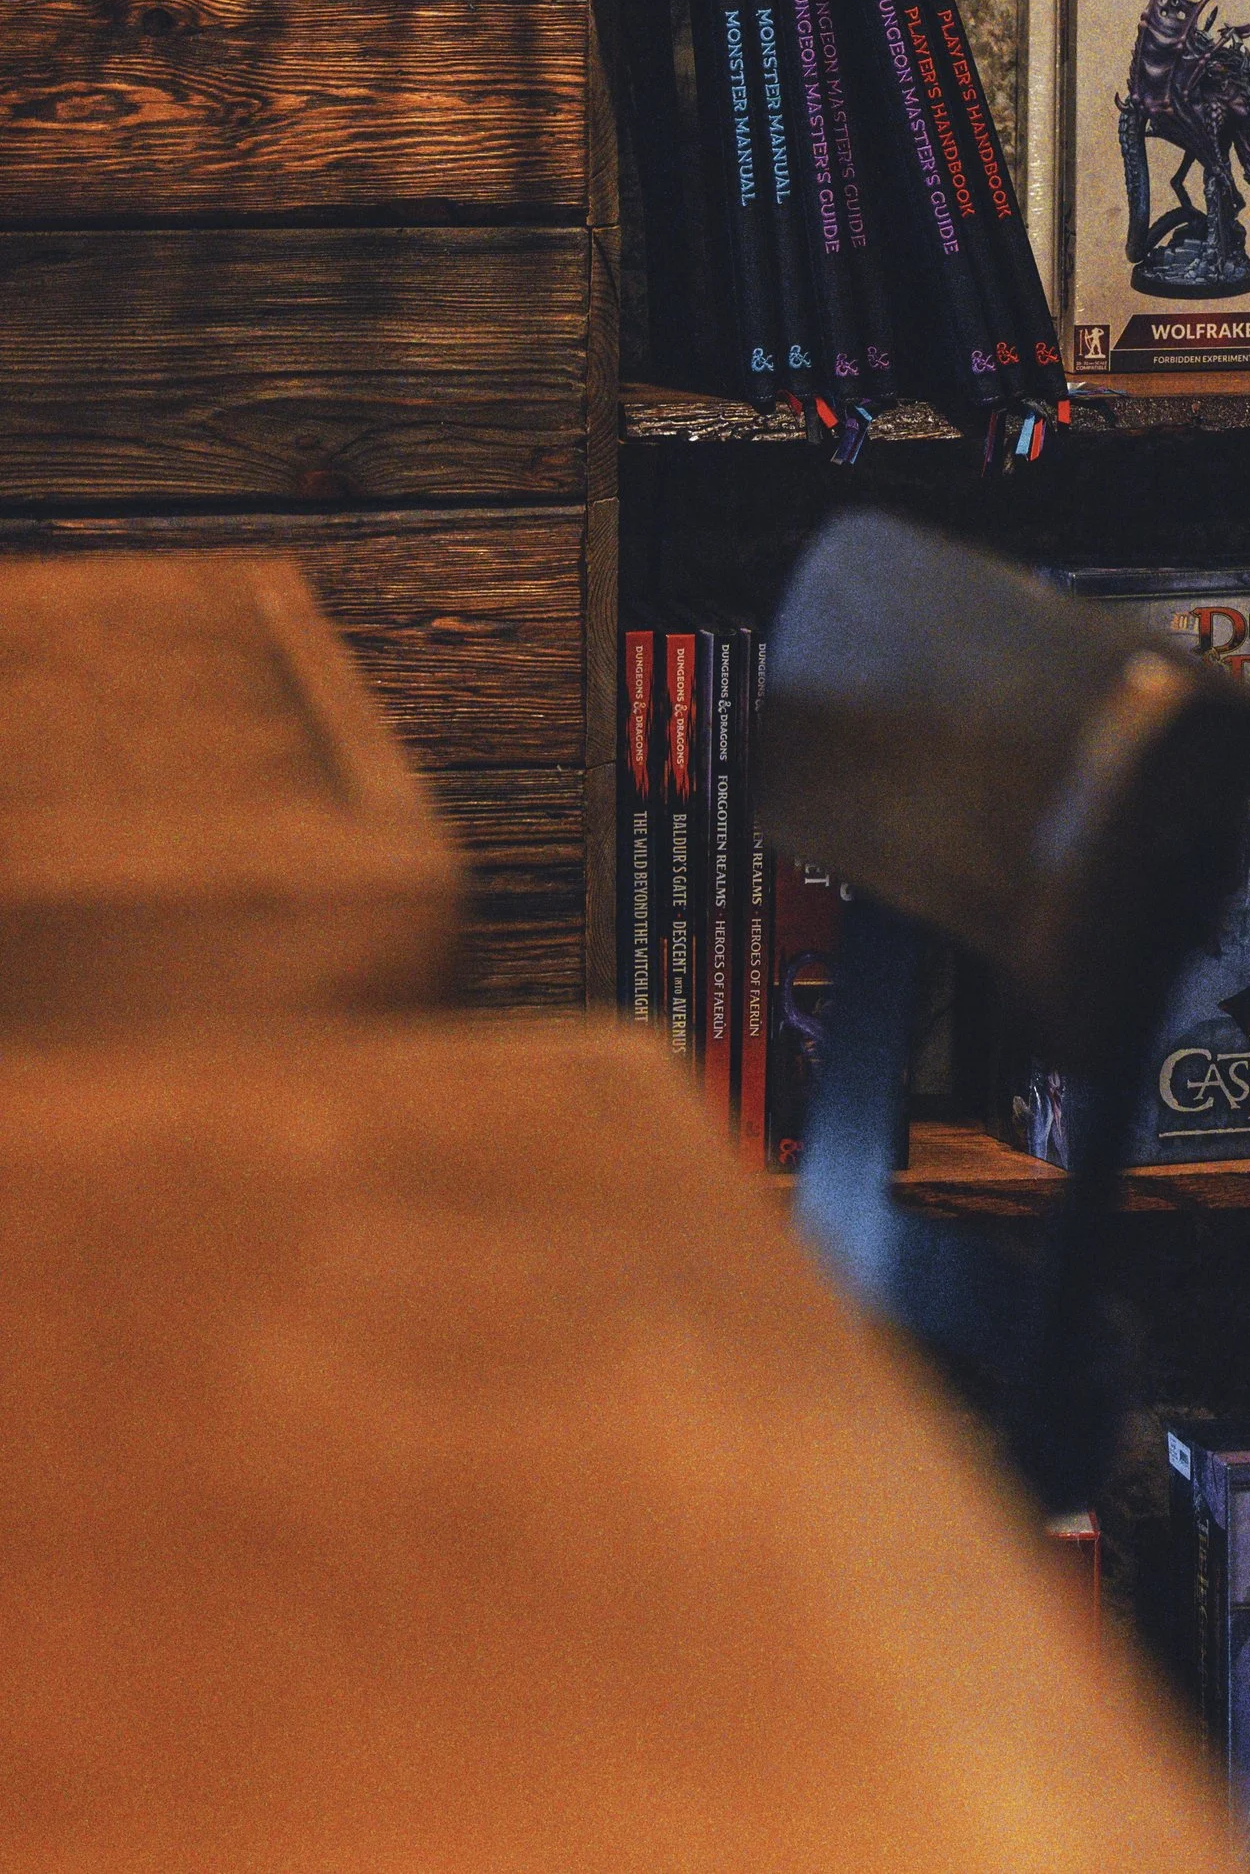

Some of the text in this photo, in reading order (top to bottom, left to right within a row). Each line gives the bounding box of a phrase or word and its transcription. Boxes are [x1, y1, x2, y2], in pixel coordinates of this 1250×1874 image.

[725, 10, 756, 207] MONSTER MANUAL
[756, 8, 791, 205] MONSTER MANUAL
[904, 6, 976, 218] PLAYER'S HANDBOOK
[937, 9, 1012, 219] PLAYER'S HANDBOOK
[805, 83, 831, 184] MASTER'S
[819, 189, 841, 254] GUIDE
[827, 78, 856, 179] MASTER'S
[844, 184, 867, 248] GUIDE
[902, 87, 941, 188] MASTER'S
[931, 191, 960, 255] GUIDE
[1153, 354, 1201, 364] FORBIDDEN
[635, 645, 644, 699] DUNGEONS
[676, 648, 685, 702] DUNGEONS
[720, 644, 730, 701] DUNGEONS
[635, 715, 644, 762] DRAGONS
[676, 718, 685, 765] DRAGONS
[719, 714, 729, 762] DRAGONS
[672, 814, 687, 907] BALDUR'S GATE
[715, 775, 728, 907] FORGOTTEN REALMS
[751, 852, 763, 905] REALMS
[633, 811, 649, 1023] THE WILD BEYOND THE WITCHLIGHT
[714, 920, 726, 968] HEROES
[751, 918, 762, 966] HEROES
[672, 921, 687, 1054] DESCENT INTO AVERNUS
[713, 972, 725, 990] OF
[751, 970, 761, 986] OF
